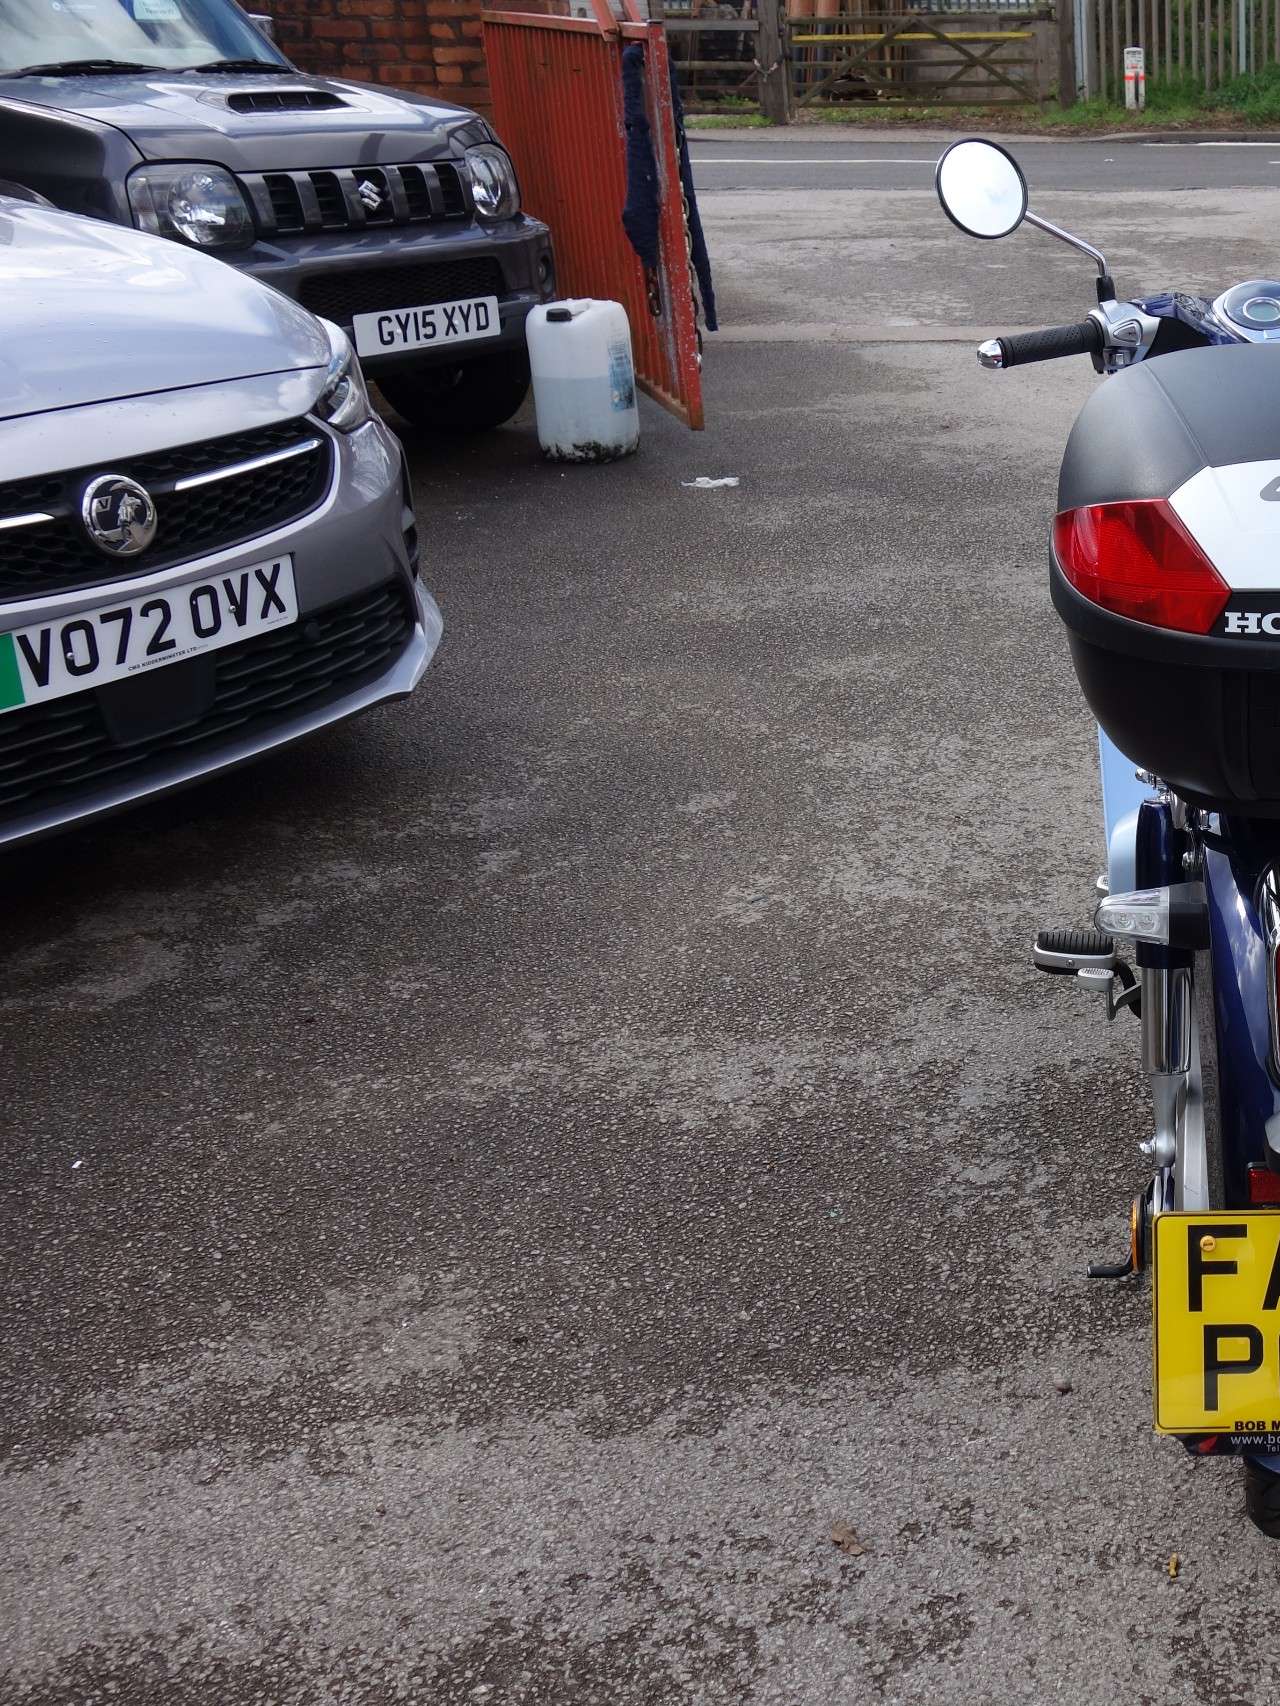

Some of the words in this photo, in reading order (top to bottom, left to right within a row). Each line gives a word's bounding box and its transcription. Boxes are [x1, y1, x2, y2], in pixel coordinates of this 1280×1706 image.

[377, 309, 437, 346] GY15
[443, 302, 490, 337] XYD
[189, 562, 287, 639] OVX
[1234, 1420, 1266, 1431] BOB
